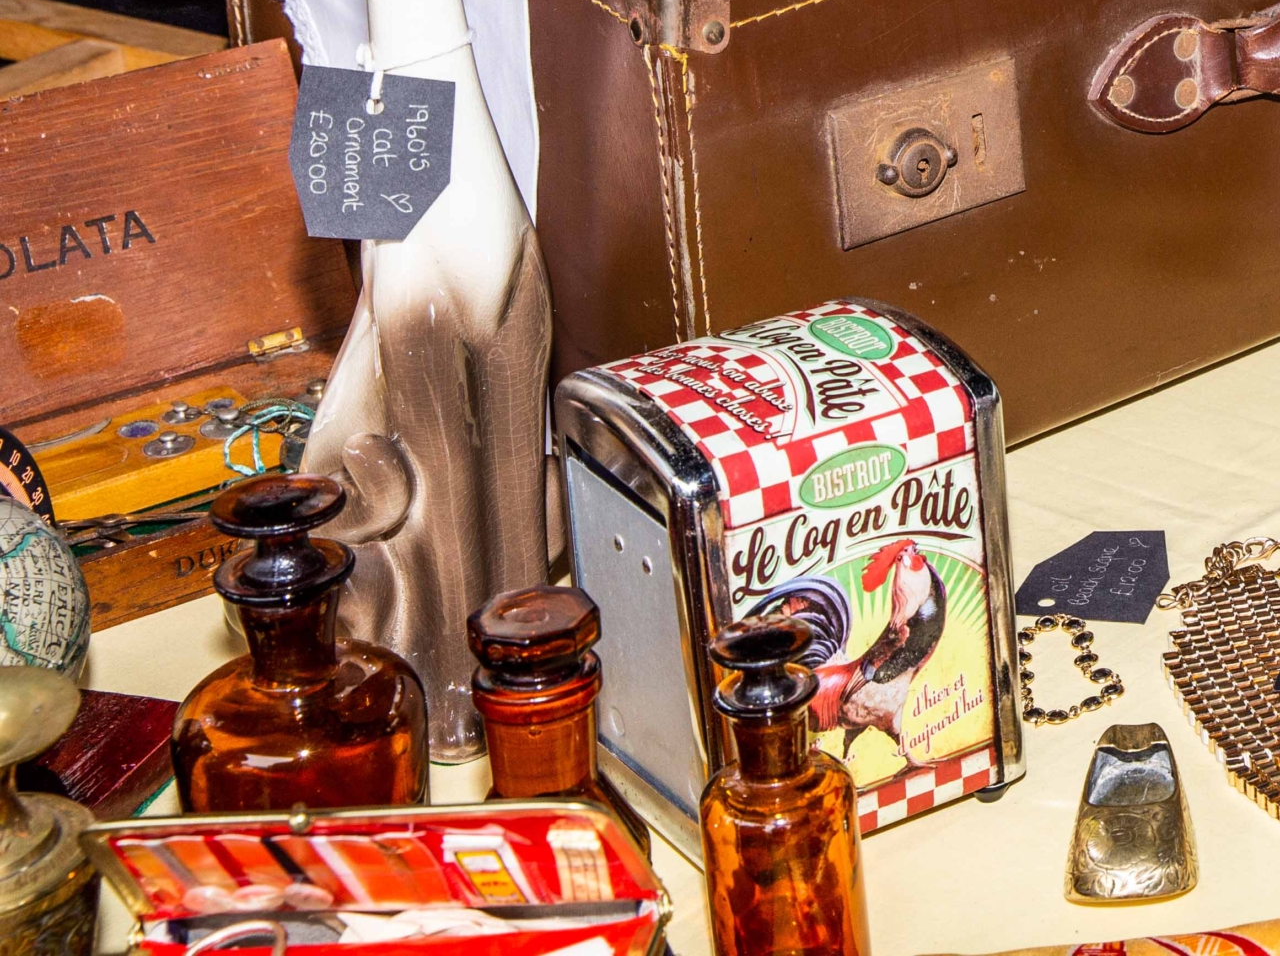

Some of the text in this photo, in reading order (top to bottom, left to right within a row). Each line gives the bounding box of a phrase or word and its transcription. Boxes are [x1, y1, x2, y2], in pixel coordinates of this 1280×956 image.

[816, 317, 888, 356] BISTROT
[664, 365, 719, 400] bonnes
[721, 362, 748, 382] on
[743, 379, 795, 414] abuse
[787, 343, 820, 363] en
[810, 359, 880, 420] Pâte
[9, 449, 21, 466] 10
[21, 465, 35, 484] 20
[812, 451, 892, 503] BISTROT
[32, 486, 44, 506] 30
[731, 468, 974, 605] Le Coq en Pâte
[911, 673, 966, 718] d'hier et
[897, 688, 985, 755] d'aujourd'hui
